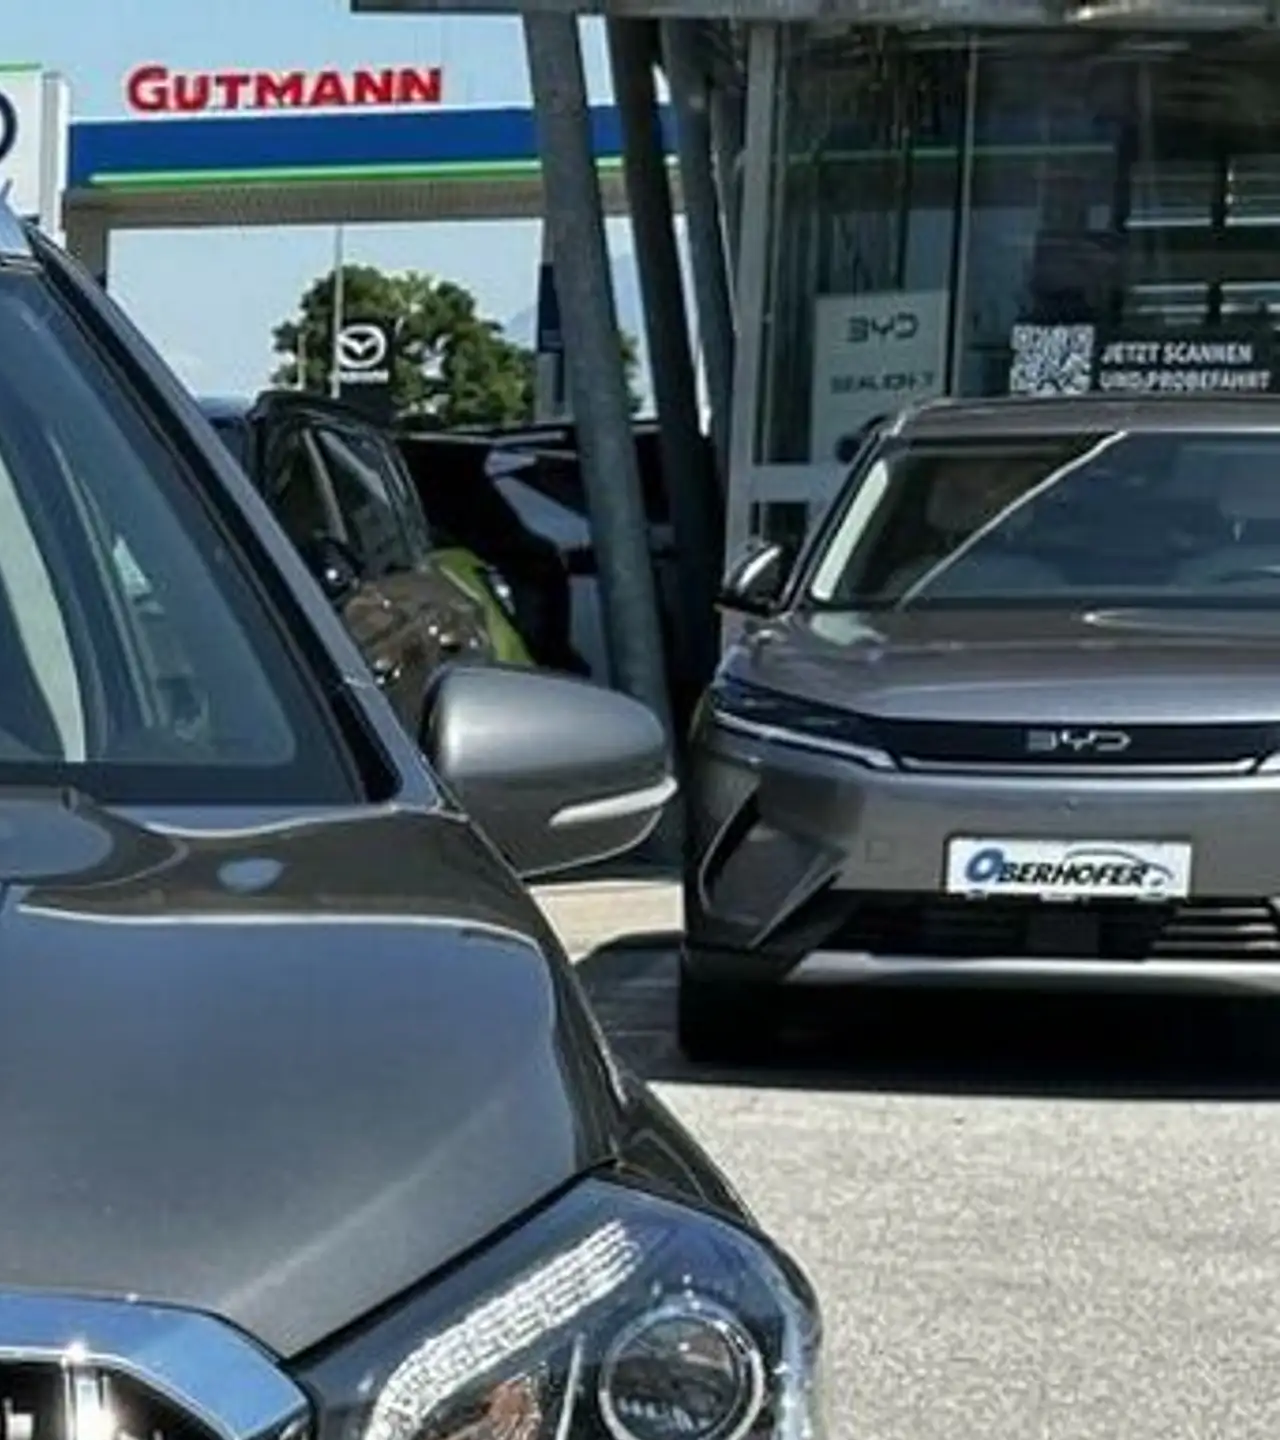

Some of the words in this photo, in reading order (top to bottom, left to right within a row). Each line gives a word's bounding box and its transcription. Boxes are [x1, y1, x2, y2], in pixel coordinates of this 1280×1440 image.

[127, 65, 441, 113] GUTMANN
[1101, 341, 1159, 364] JETZT
[1163, 341, 1253, 364] SCANNEN
[1026, 729, 1131, 751] BYD
[964, 848, 1154, 886] OBERHOFER
